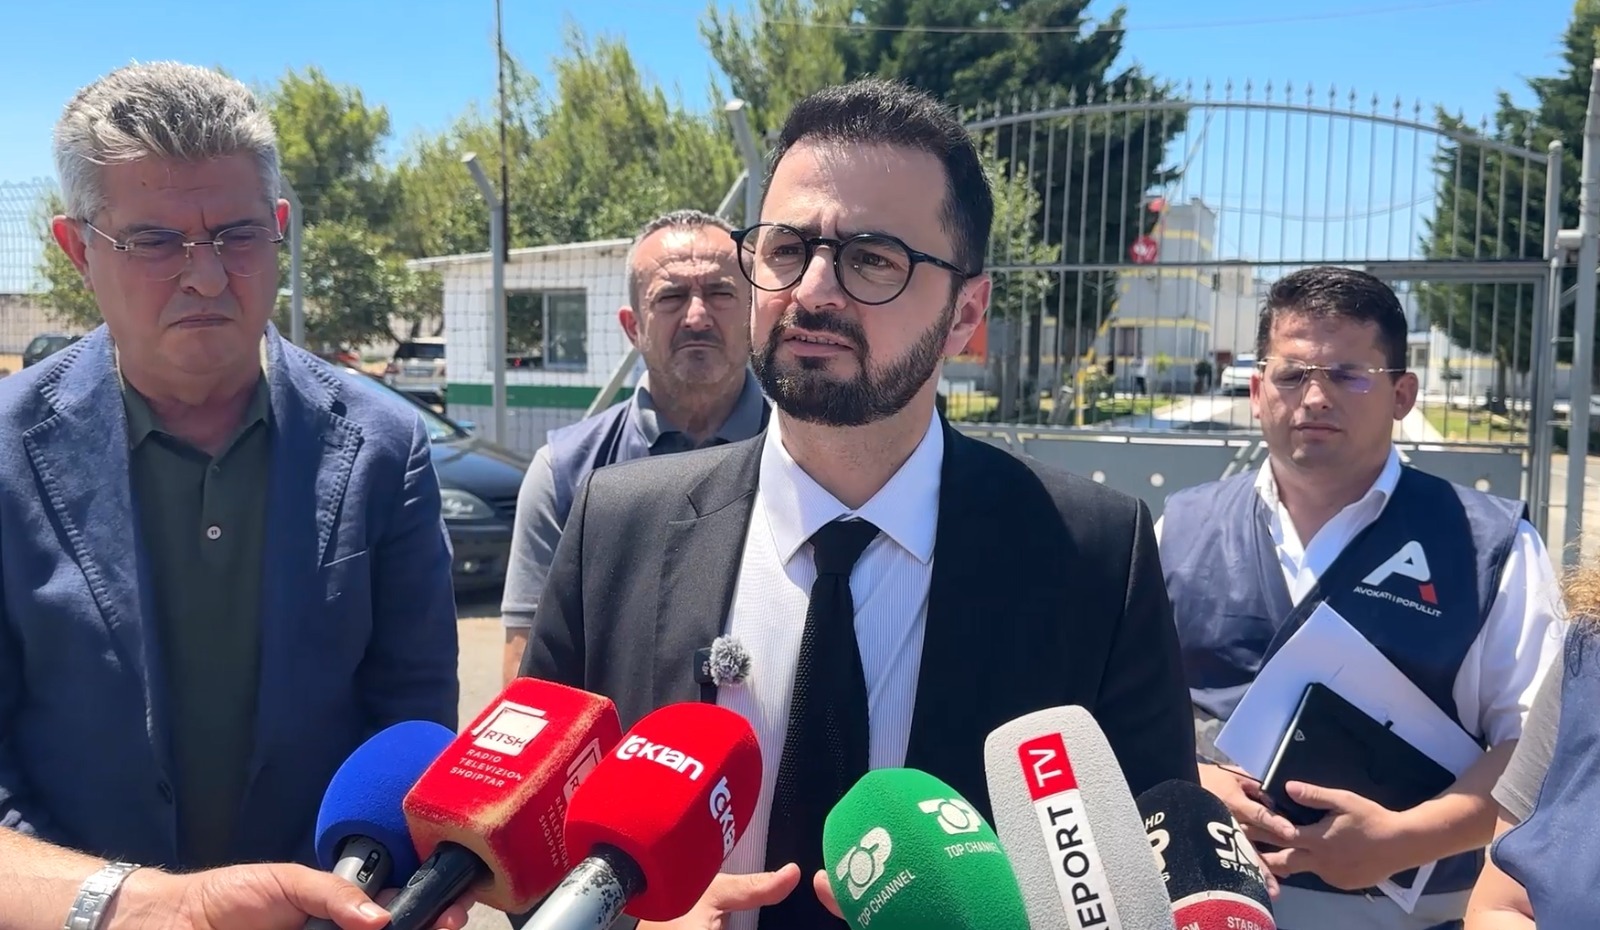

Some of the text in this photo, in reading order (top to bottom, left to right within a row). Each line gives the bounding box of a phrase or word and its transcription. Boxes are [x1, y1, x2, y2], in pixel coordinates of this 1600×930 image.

[1353, 586, 1392, 601] AVOKATI
[1396, 597, 1442, 618] POPULLIT
[483, 730, 527, 748] RTSH
[466, 749, 502, 763] RADIO
[449, 767, 505, 788] SHQIPTAR
[1144, 811, 1165, 831] HD
[538, 814, 560, 868] SHQIPTAR
[1028, 748, 1109, 930] EPORT TV
[944, 843, 965, 859] TOP
[1219, 859, 1247, 878] STAR
[857, 868, 916, 929] TOP CHANNEL
